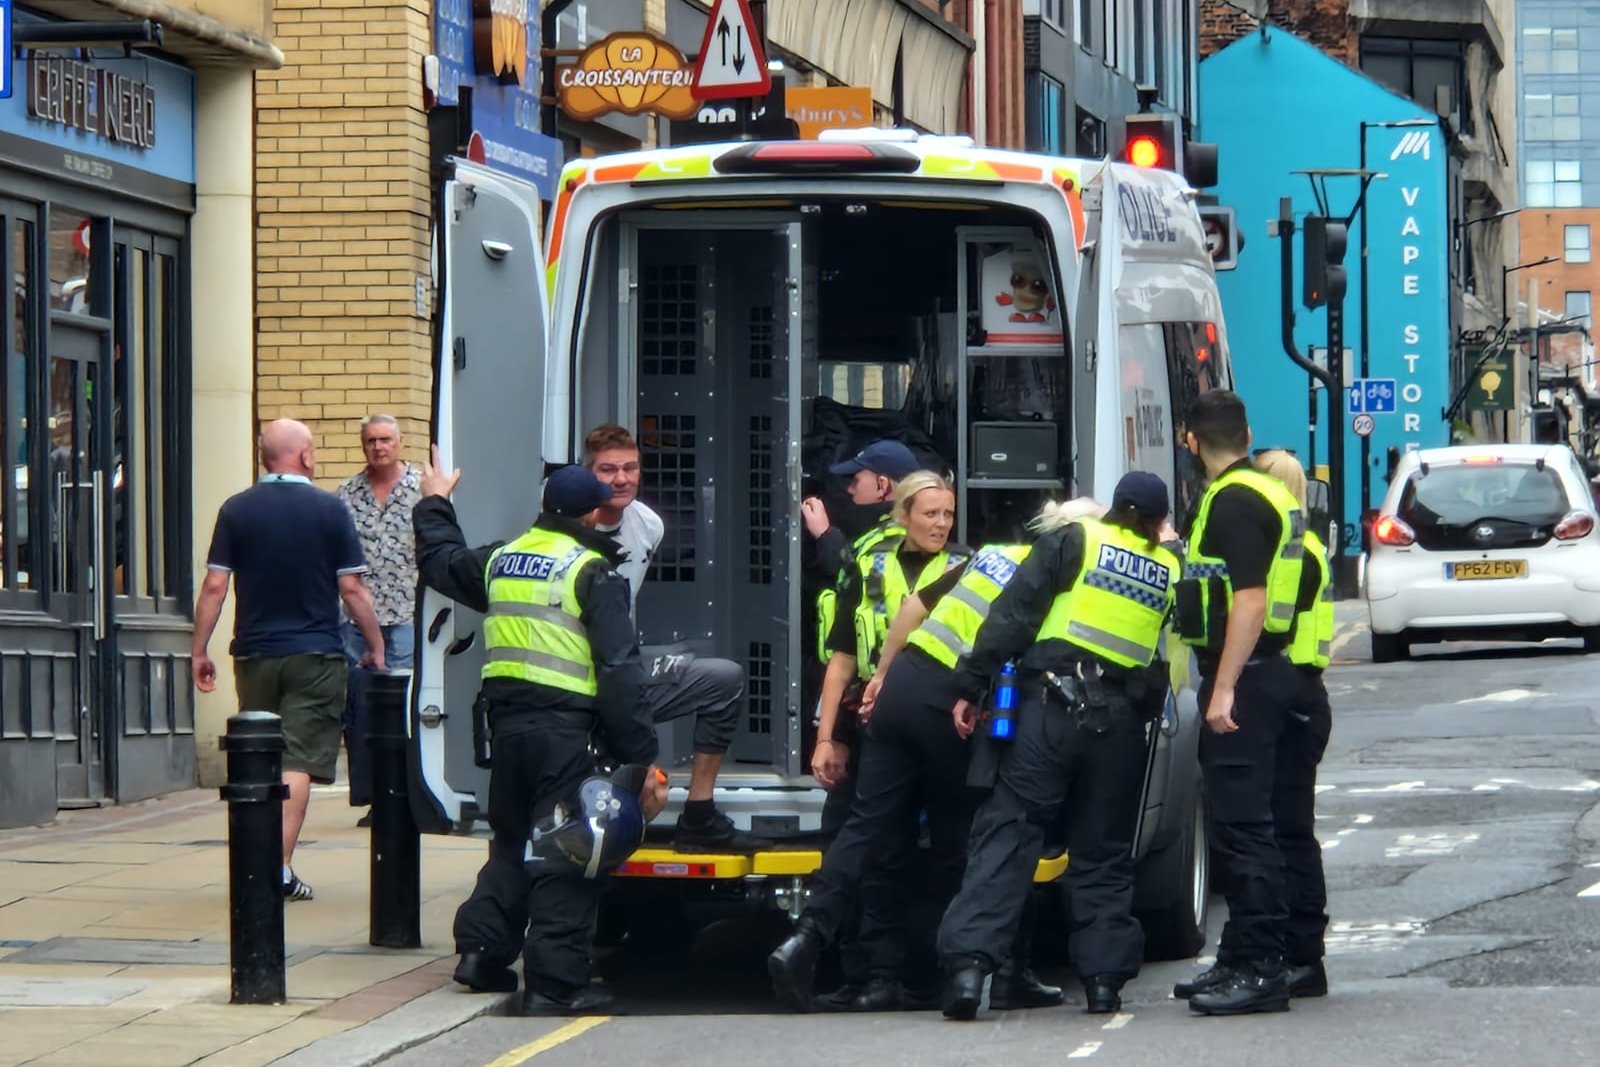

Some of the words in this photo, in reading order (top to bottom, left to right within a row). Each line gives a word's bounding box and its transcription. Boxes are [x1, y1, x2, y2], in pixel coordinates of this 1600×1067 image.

[621, 47, 642, 61] LA
[103, 70, 154, 148] NERO
[1118, 182, 1176, 241] OLICE
[1401, 187, 1420, 295] VAPE
[1355, 417, 1372, 431] 20
[496, 555, 552, 576] POLICE
[1099, 547, 1168, 588] POLICE
